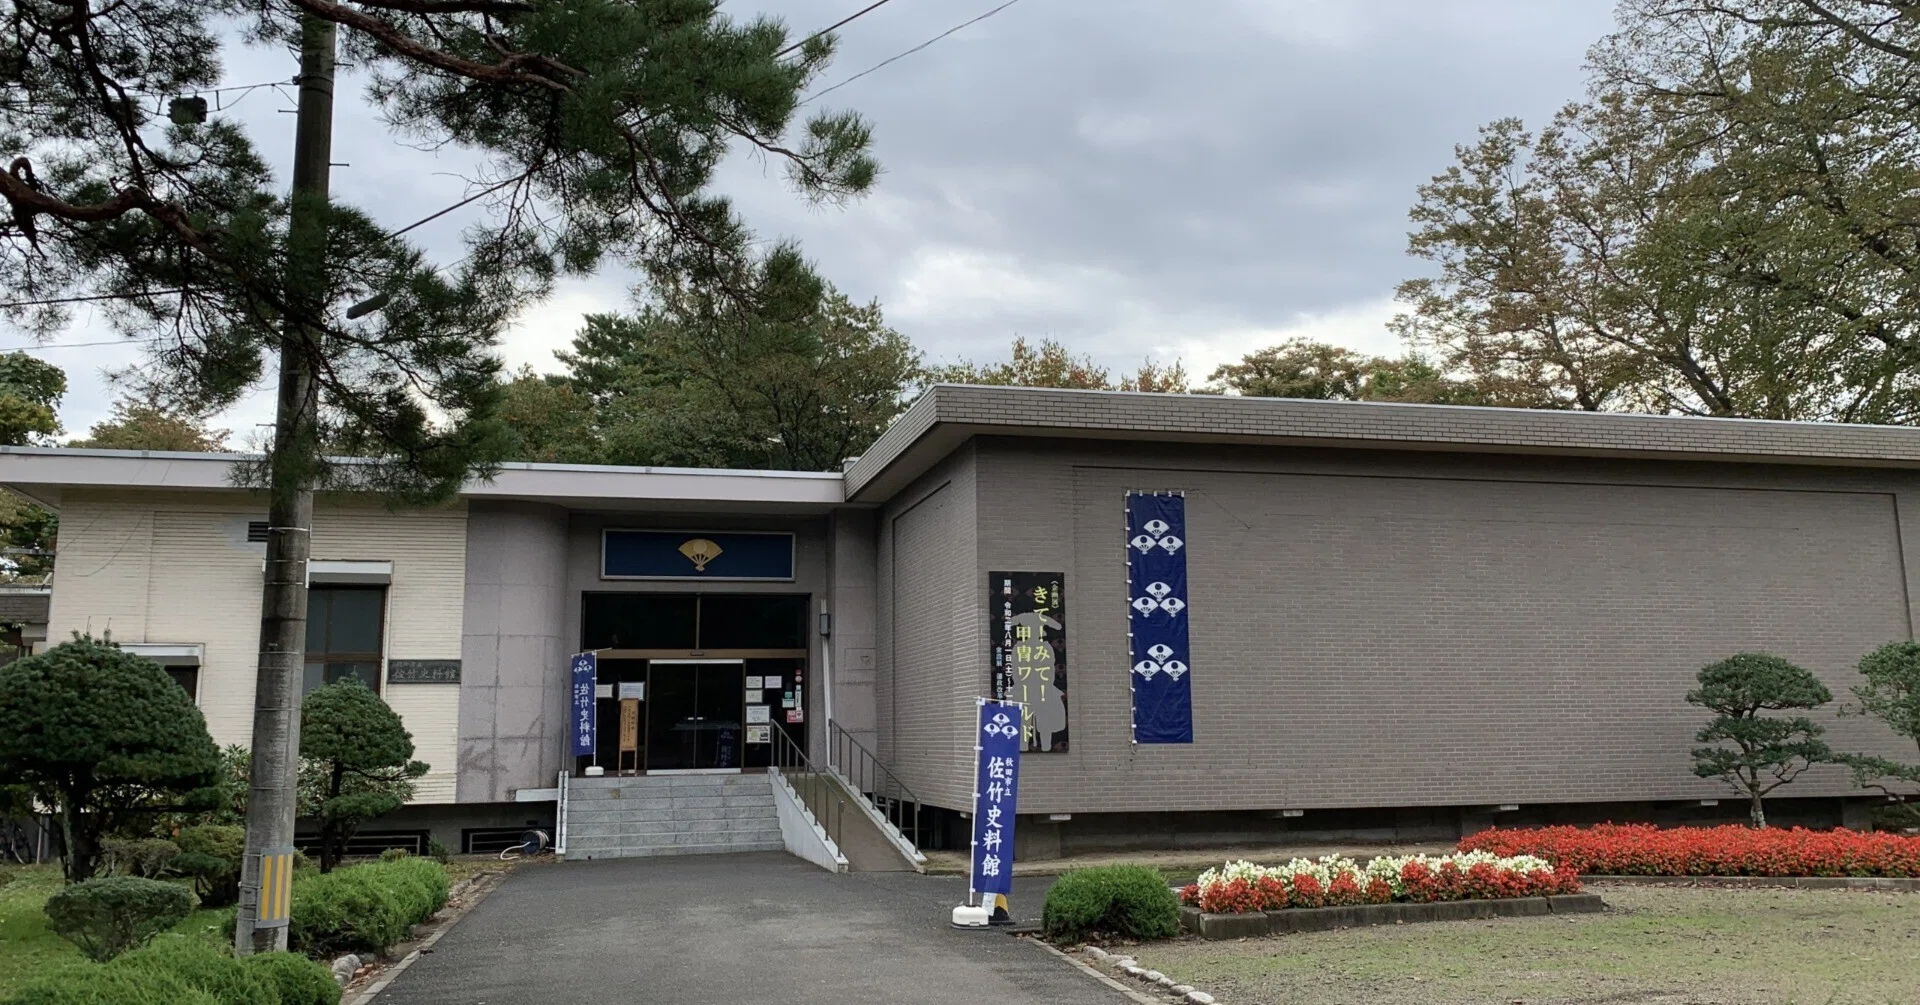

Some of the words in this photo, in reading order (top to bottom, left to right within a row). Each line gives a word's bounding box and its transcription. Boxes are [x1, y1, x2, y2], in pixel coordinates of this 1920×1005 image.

[392, 668, 457, 680] 佐竹史料館
[1016, 626, 1034, 742] 甲冑ワールド
[1033, 586, 1051, 702] きて！みて！
[981, 756, 1005, 878] 佐竹史料館
[1003, 757, 1014, 797] 秋田市立
